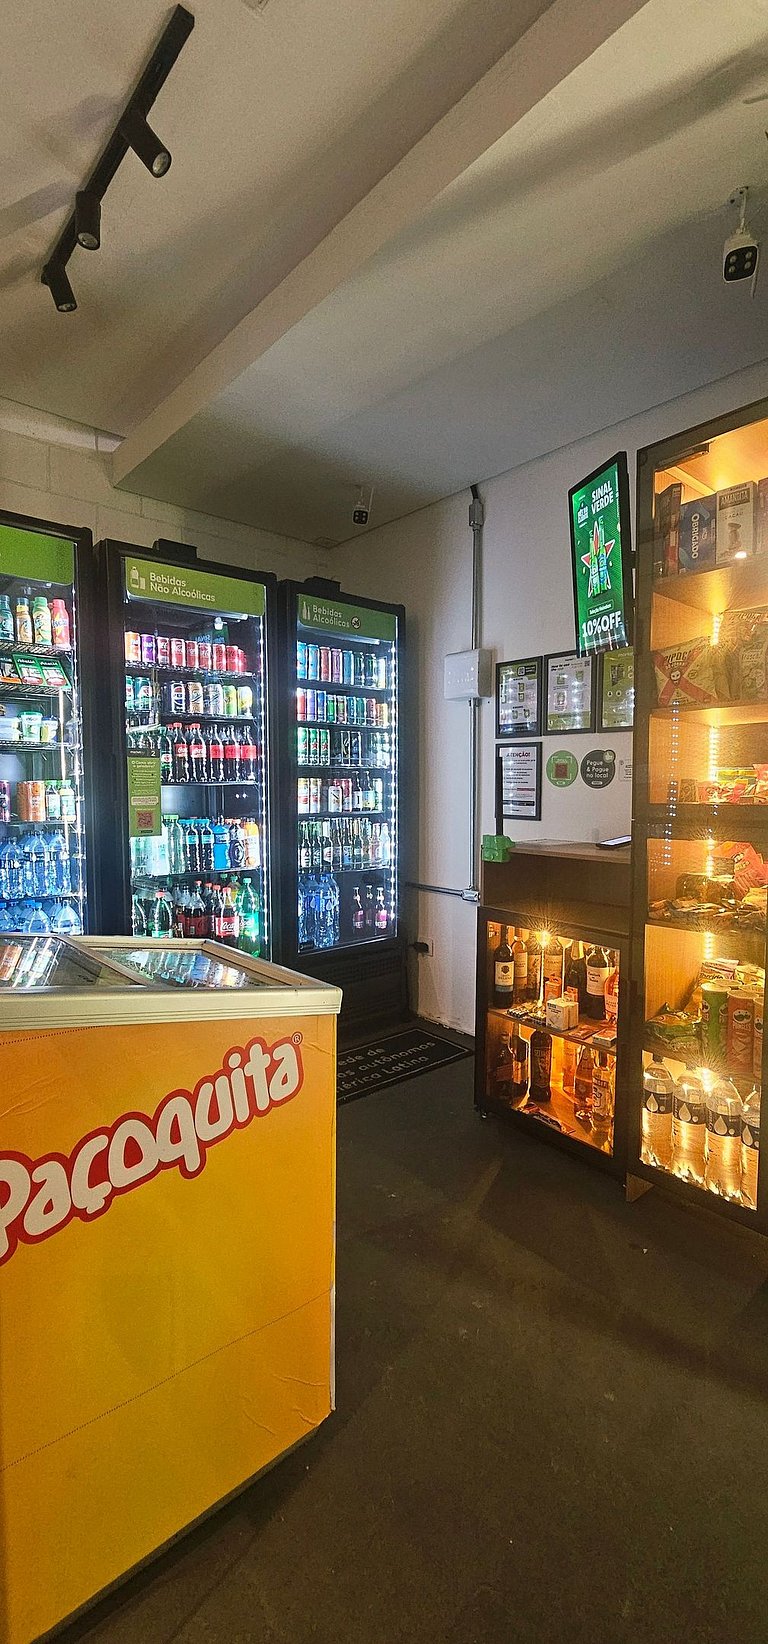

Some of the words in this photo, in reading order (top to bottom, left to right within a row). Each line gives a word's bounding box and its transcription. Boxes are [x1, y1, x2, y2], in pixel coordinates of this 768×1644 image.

[591, 480, 613, 503] SINAL
[591, 491, 614, 515] VERDE
[691, 513, 700, 559] OBRIGADO
[149, 572, 187, 588] Bebidas
[150, 582, 170, 594] Não
[172, 587, 216, 602] Alcoólicas
[312, 604, 342, 618] Bebidas
[312, 614, 350, 628] Alcoólicas
[338, 1055, 364, 1066] ede
[367, 1048, 385, 1057] de
[381, 1056, 429, 1075] Latina
[0, 1043, 300, 1258] Paçoquita
